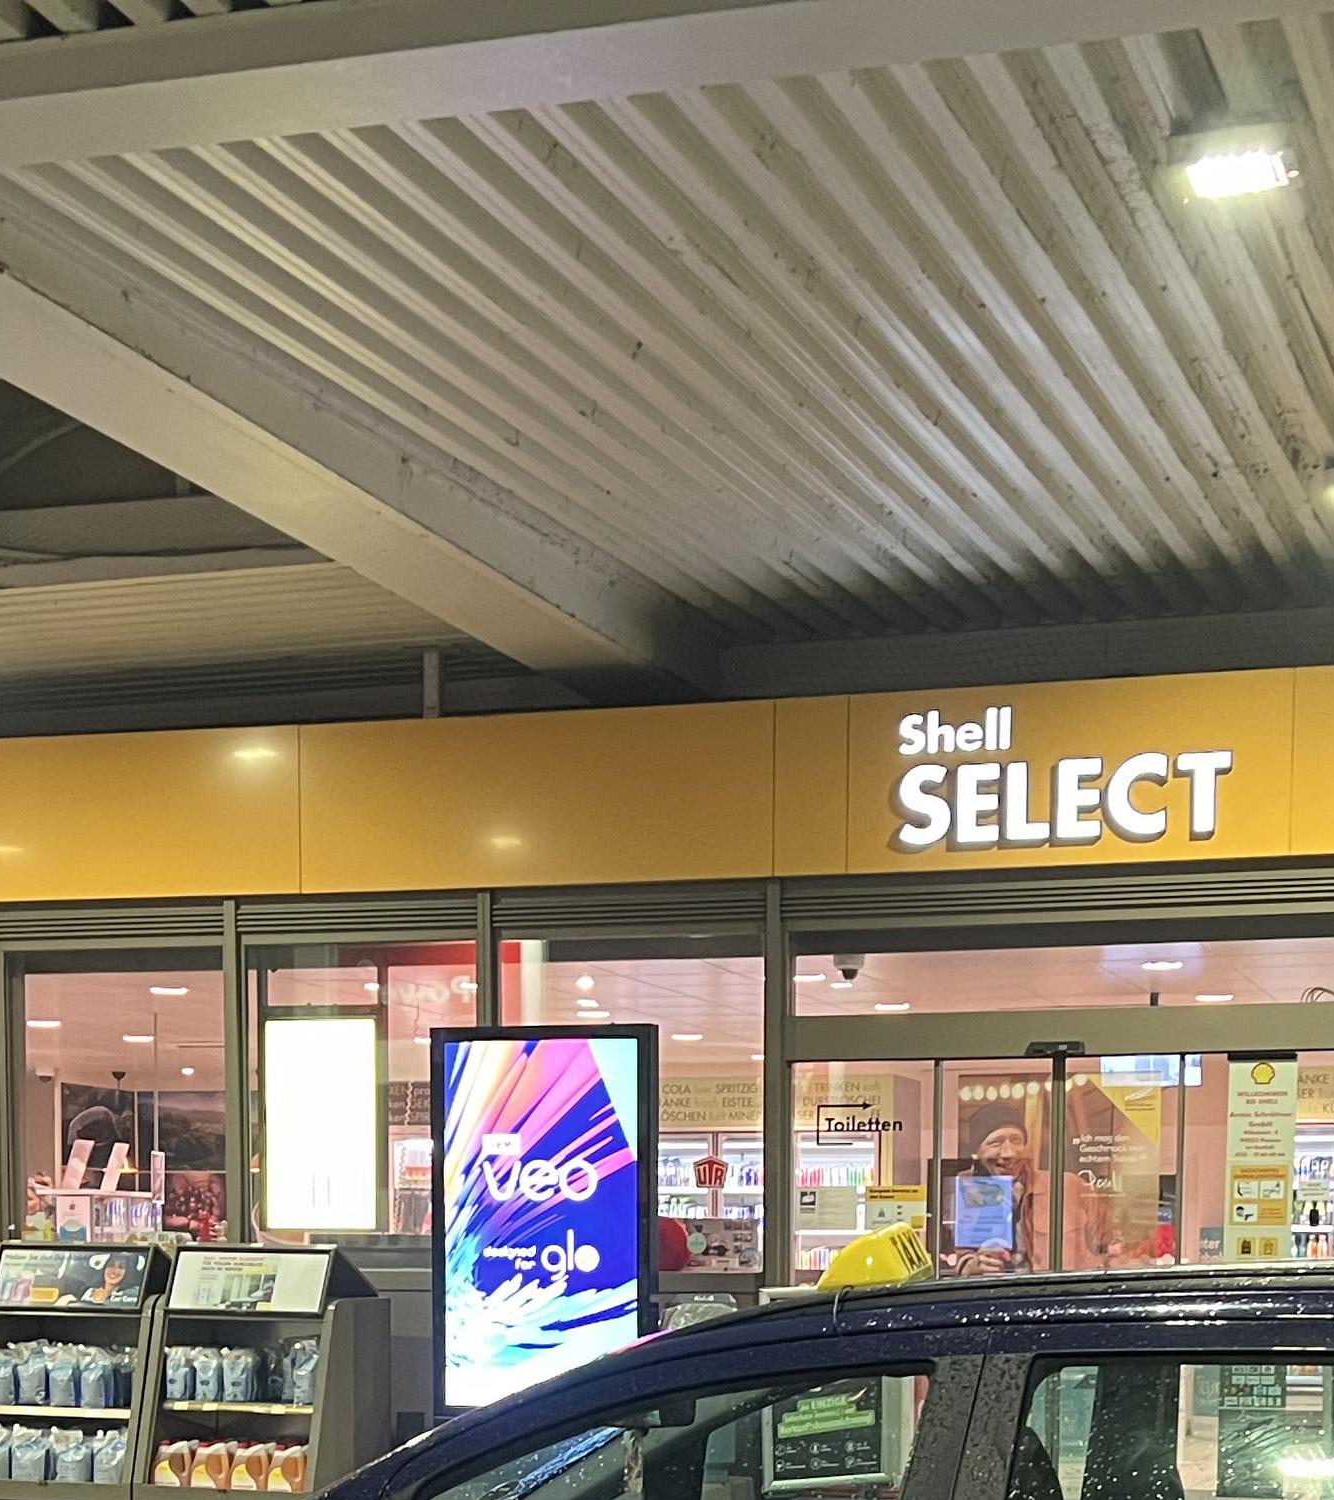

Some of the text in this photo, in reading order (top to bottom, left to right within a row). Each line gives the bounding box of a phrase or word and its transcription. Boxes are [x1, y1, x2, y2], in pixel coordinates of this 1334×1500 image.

[898, 705, 1013, 756] Shell
[894, 751, 1233, 848] SELECT
[824, 1115, 903, 1133] Toiletten
[540, 1228, 601, 1282] glo
